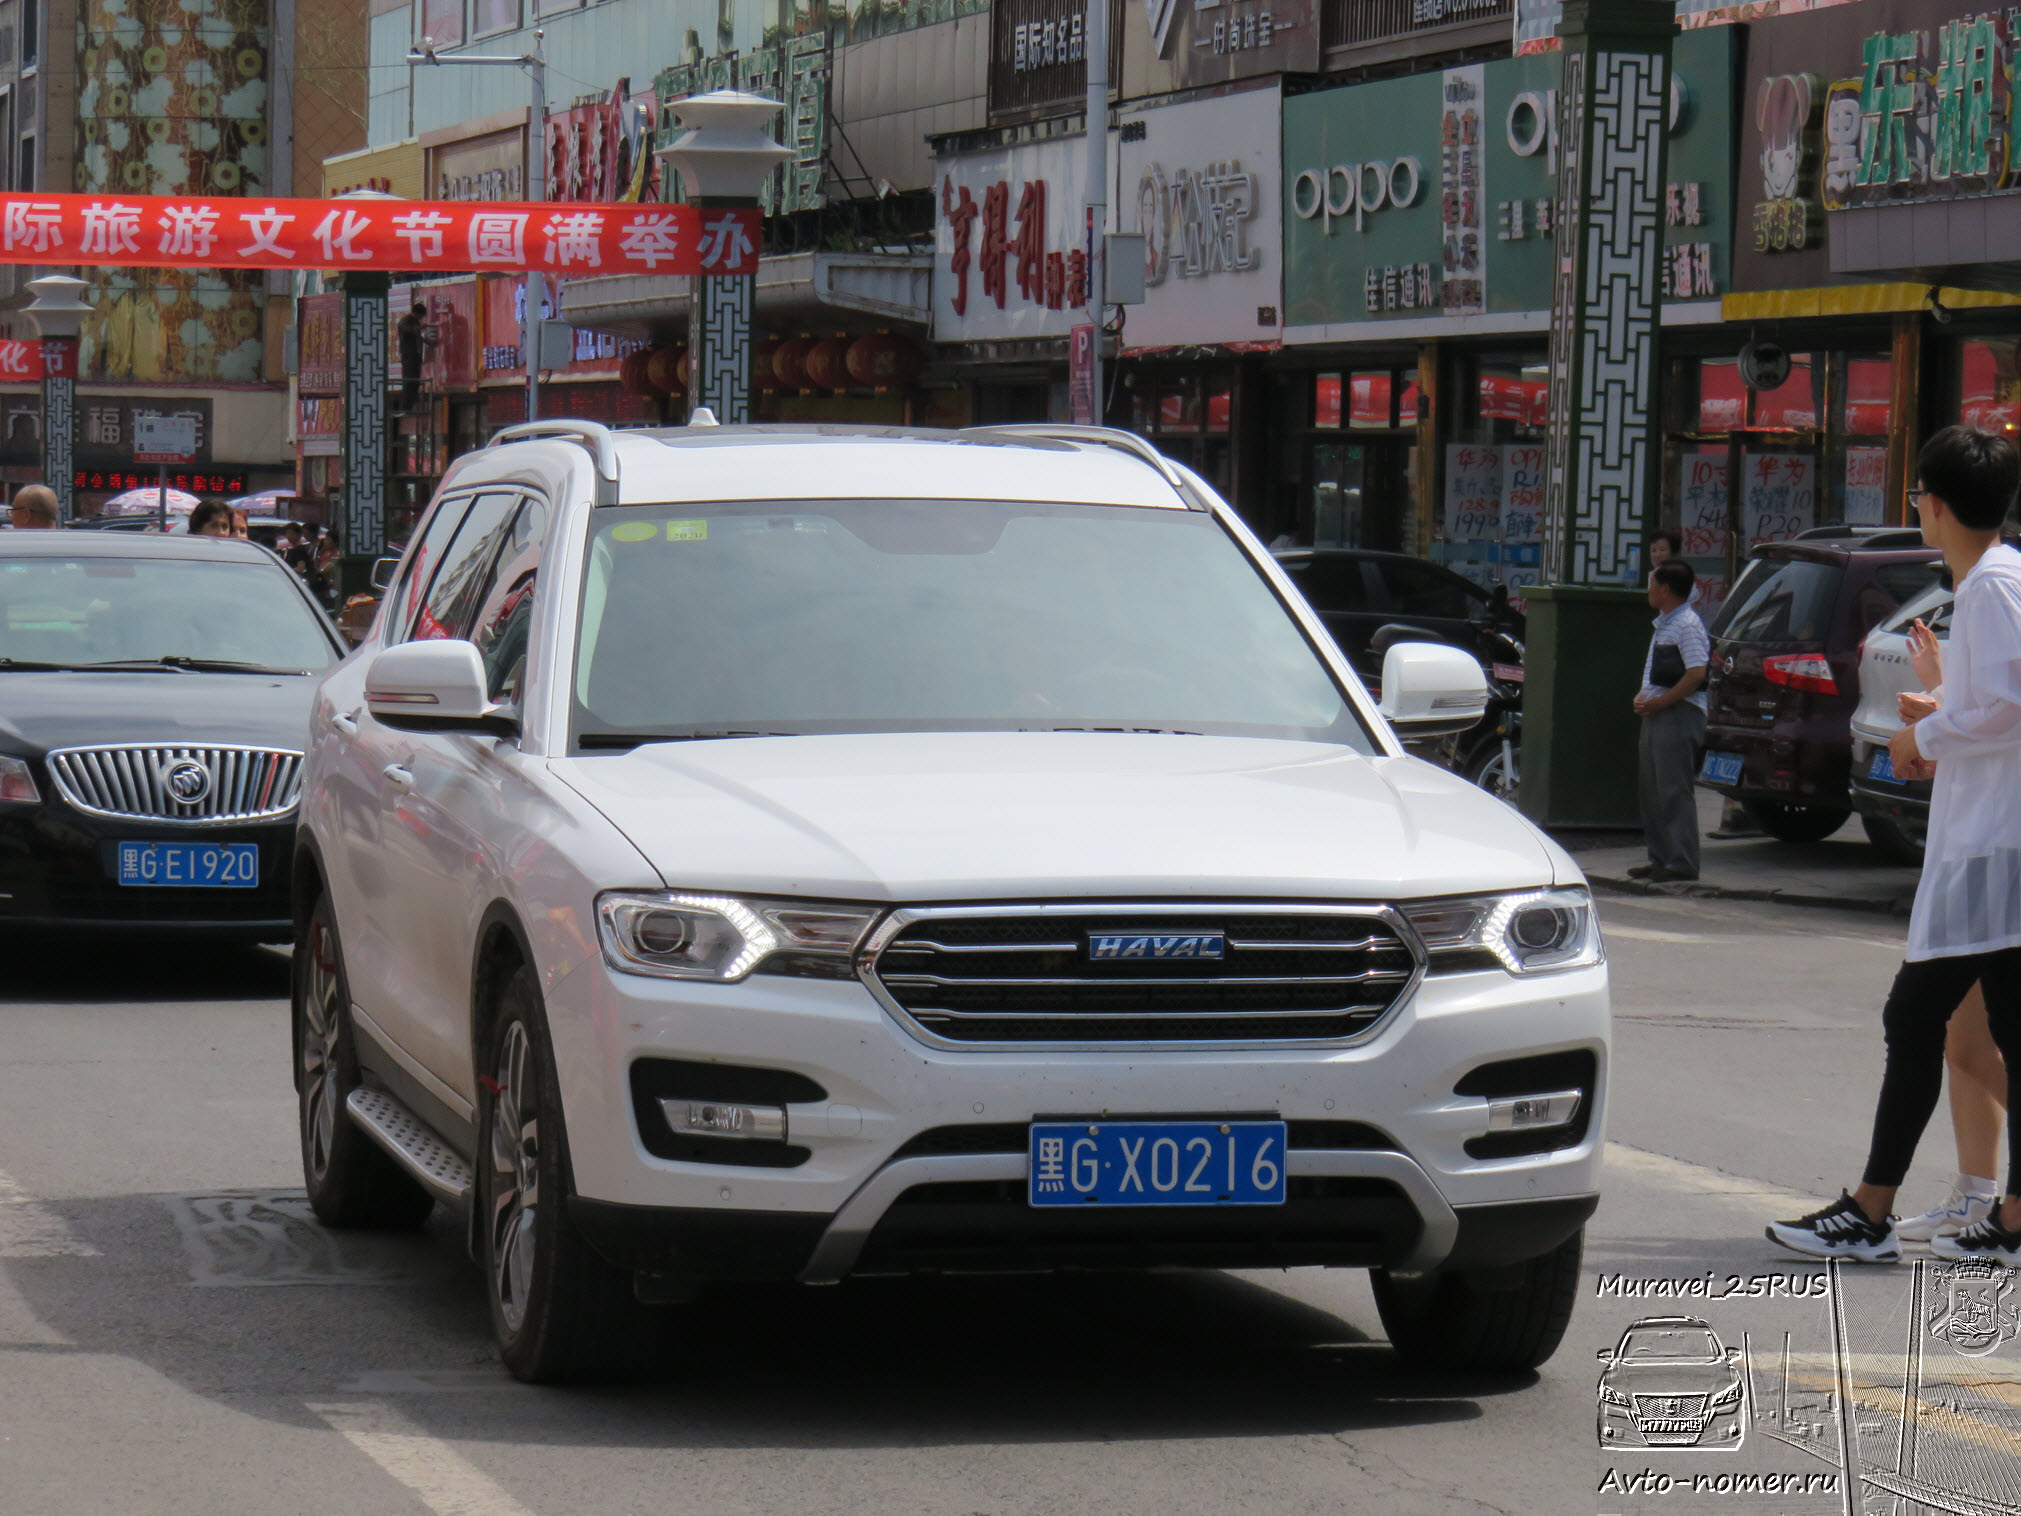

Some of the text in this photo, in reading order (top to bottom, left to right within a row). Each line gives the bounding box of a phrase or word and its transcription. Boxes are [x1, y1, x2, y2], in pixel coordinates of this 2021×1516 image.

[1014, 13, 1088, 74] 国际知名品
[4, 202, 754, 269] 际旅游文化节圆满举办
[1754, 454, 1807, 487] 华为
[1757, 514, 1801, 537] P20
[123, 849, 254, 881] 黑G·E1920
[1095, 937, 1221, 957] HAVAL
[1038, 1137, 1279, 1193] 黑G·X0216
